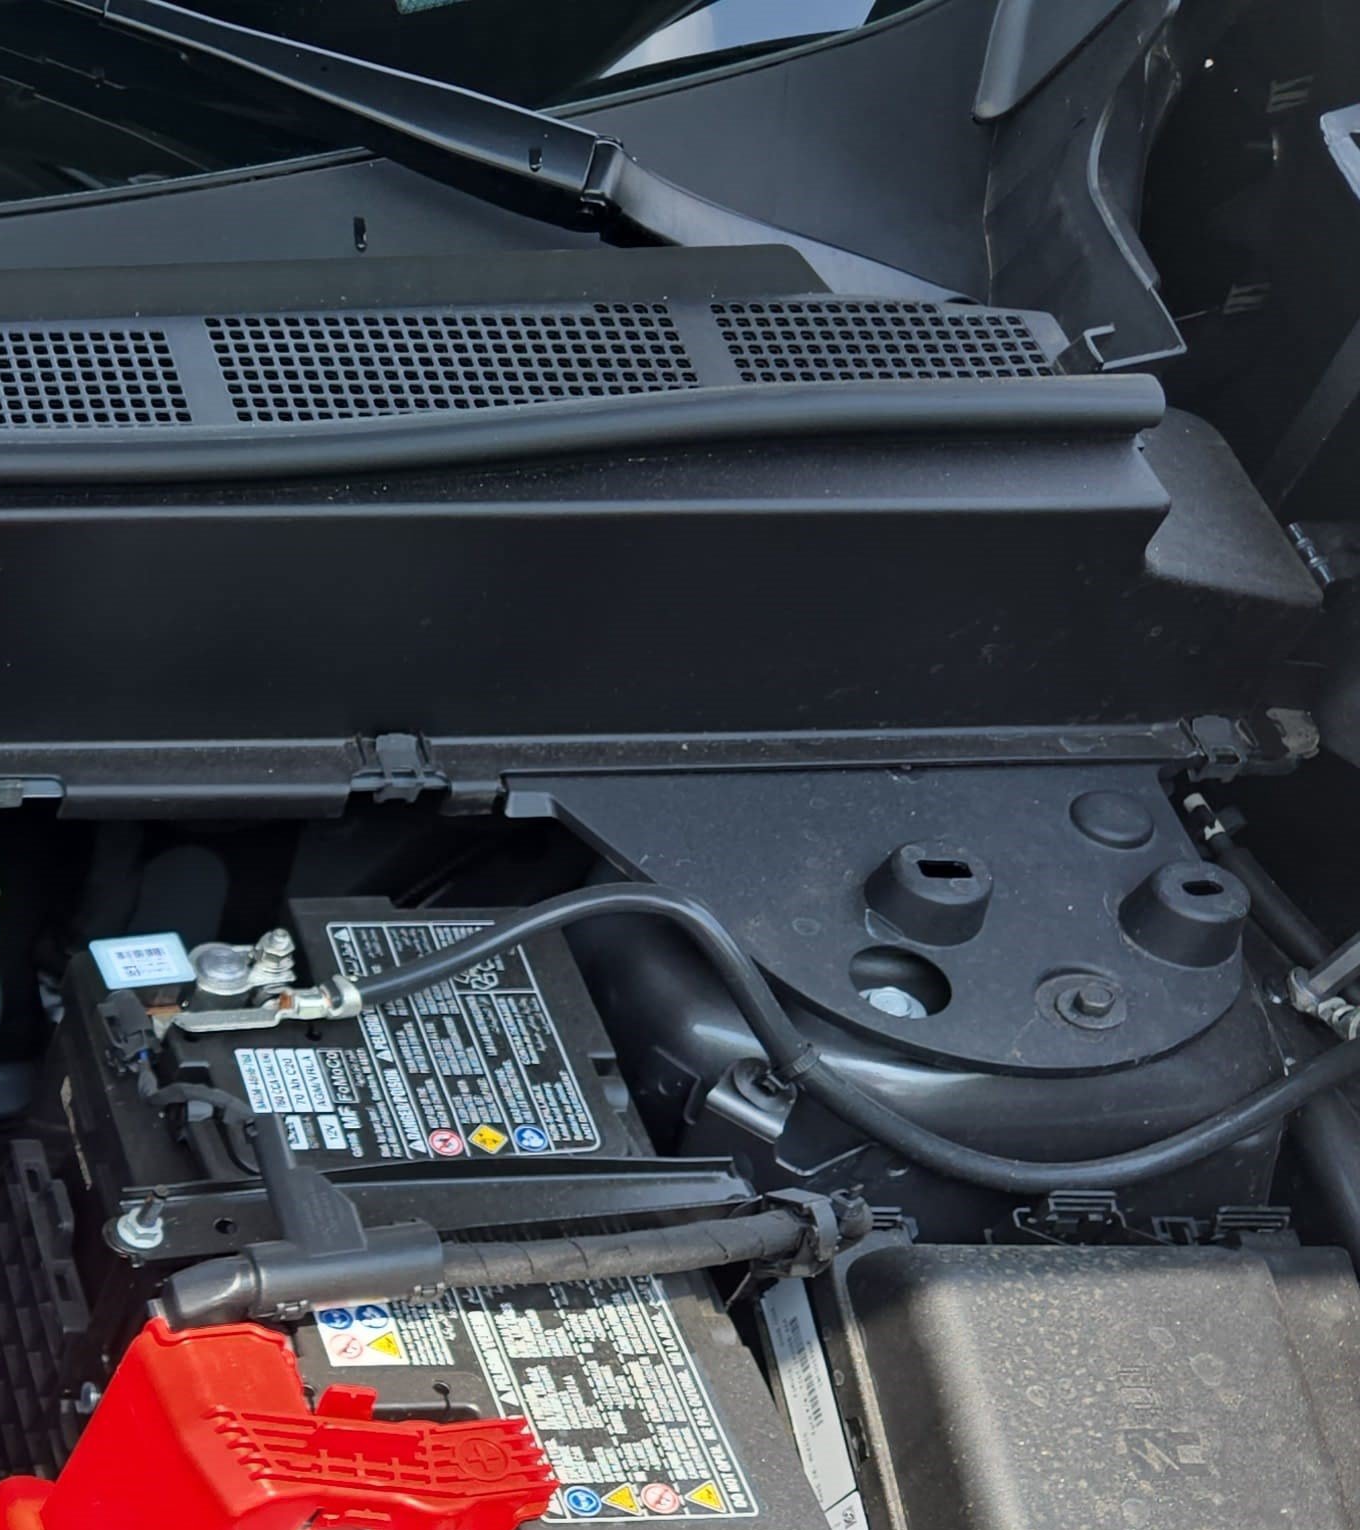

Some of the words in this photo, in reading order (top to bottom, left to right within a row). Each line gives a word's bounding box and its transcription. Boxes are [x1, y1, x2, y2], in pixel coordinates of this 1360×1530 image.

[322, 1052, 353, 1101] FoMoCo
[294, 1094, 306, 1103] 70
[335, 1105, 362, 1128] MF
[323, 1124, 338, 1140] 12V
[660, 1339, 678, 1351] LA
[690, 1407, 711, 1426] PAS
[719, 1472, 741, 1491] NOT
[728, 1493, 748, 1507] DO
